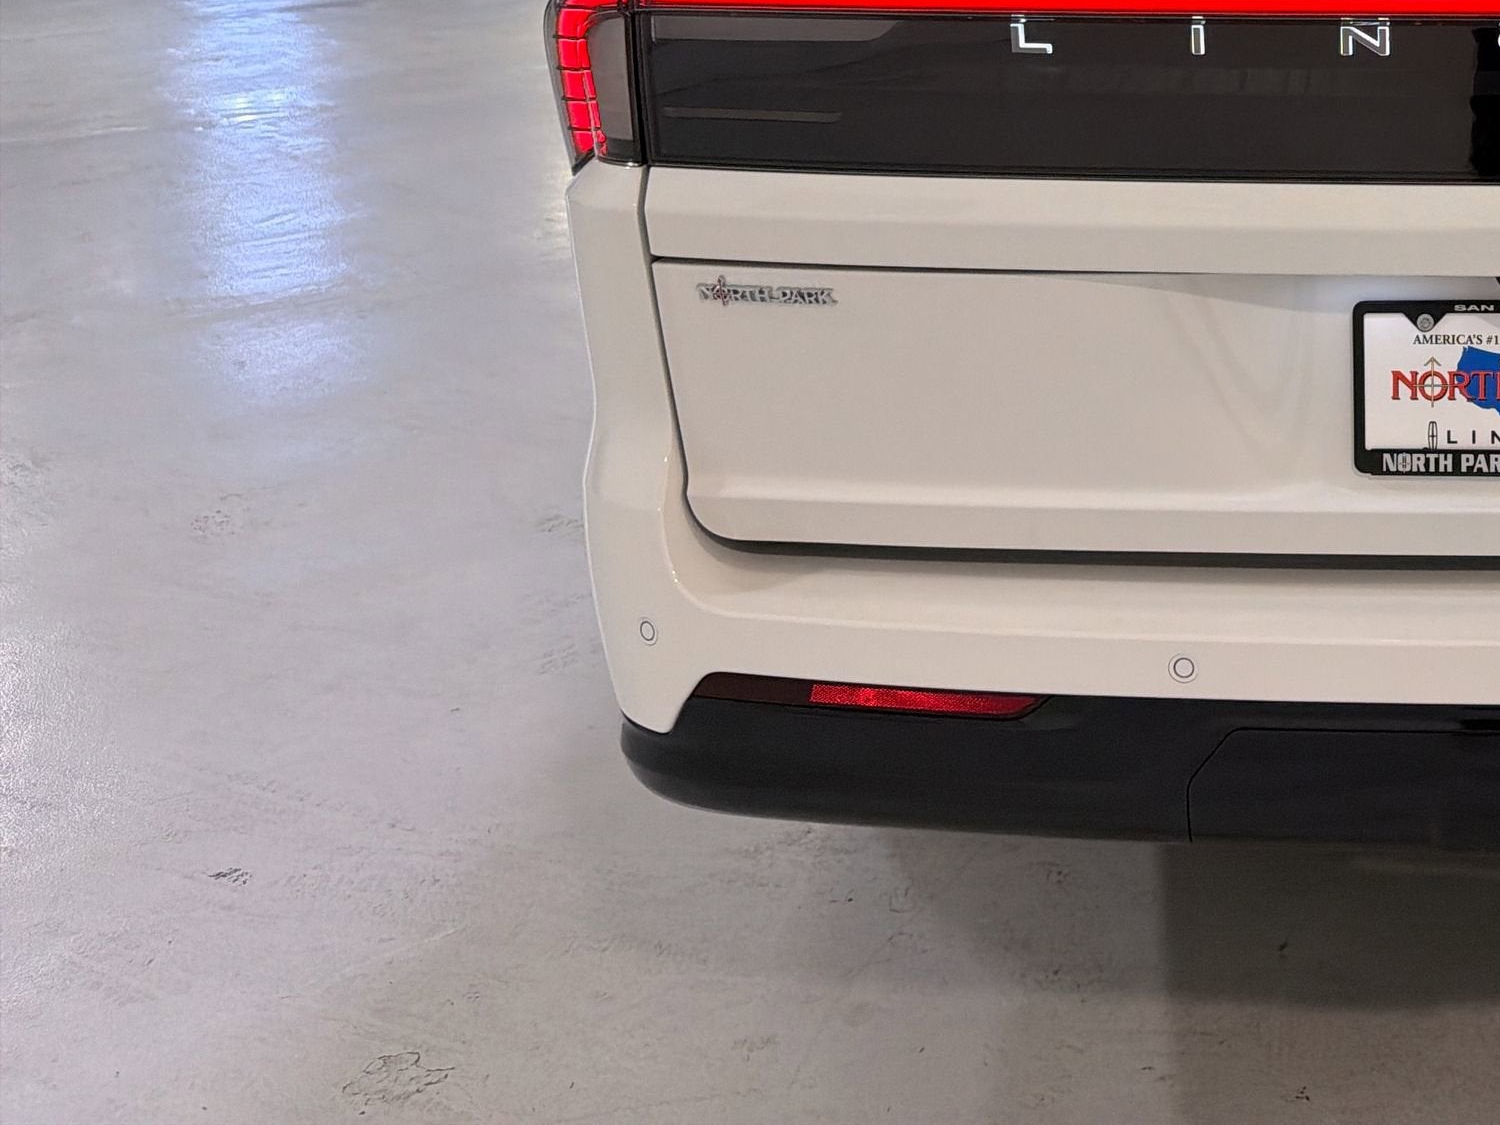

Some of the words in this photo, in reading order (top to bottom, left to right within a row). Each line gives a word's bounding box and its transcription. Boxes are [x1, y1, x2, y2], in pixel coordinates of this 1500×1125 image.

[698, 280, 773, 305] NORTH
[775, 286, 837, 305] PARK
[1453, 304, 1495, 312] SAN
[1413, 333, 1483, 345] AMERICA'S
[1486, 334, 1499, 345] #1
[1382, 453, 1453, 473] NORTH
